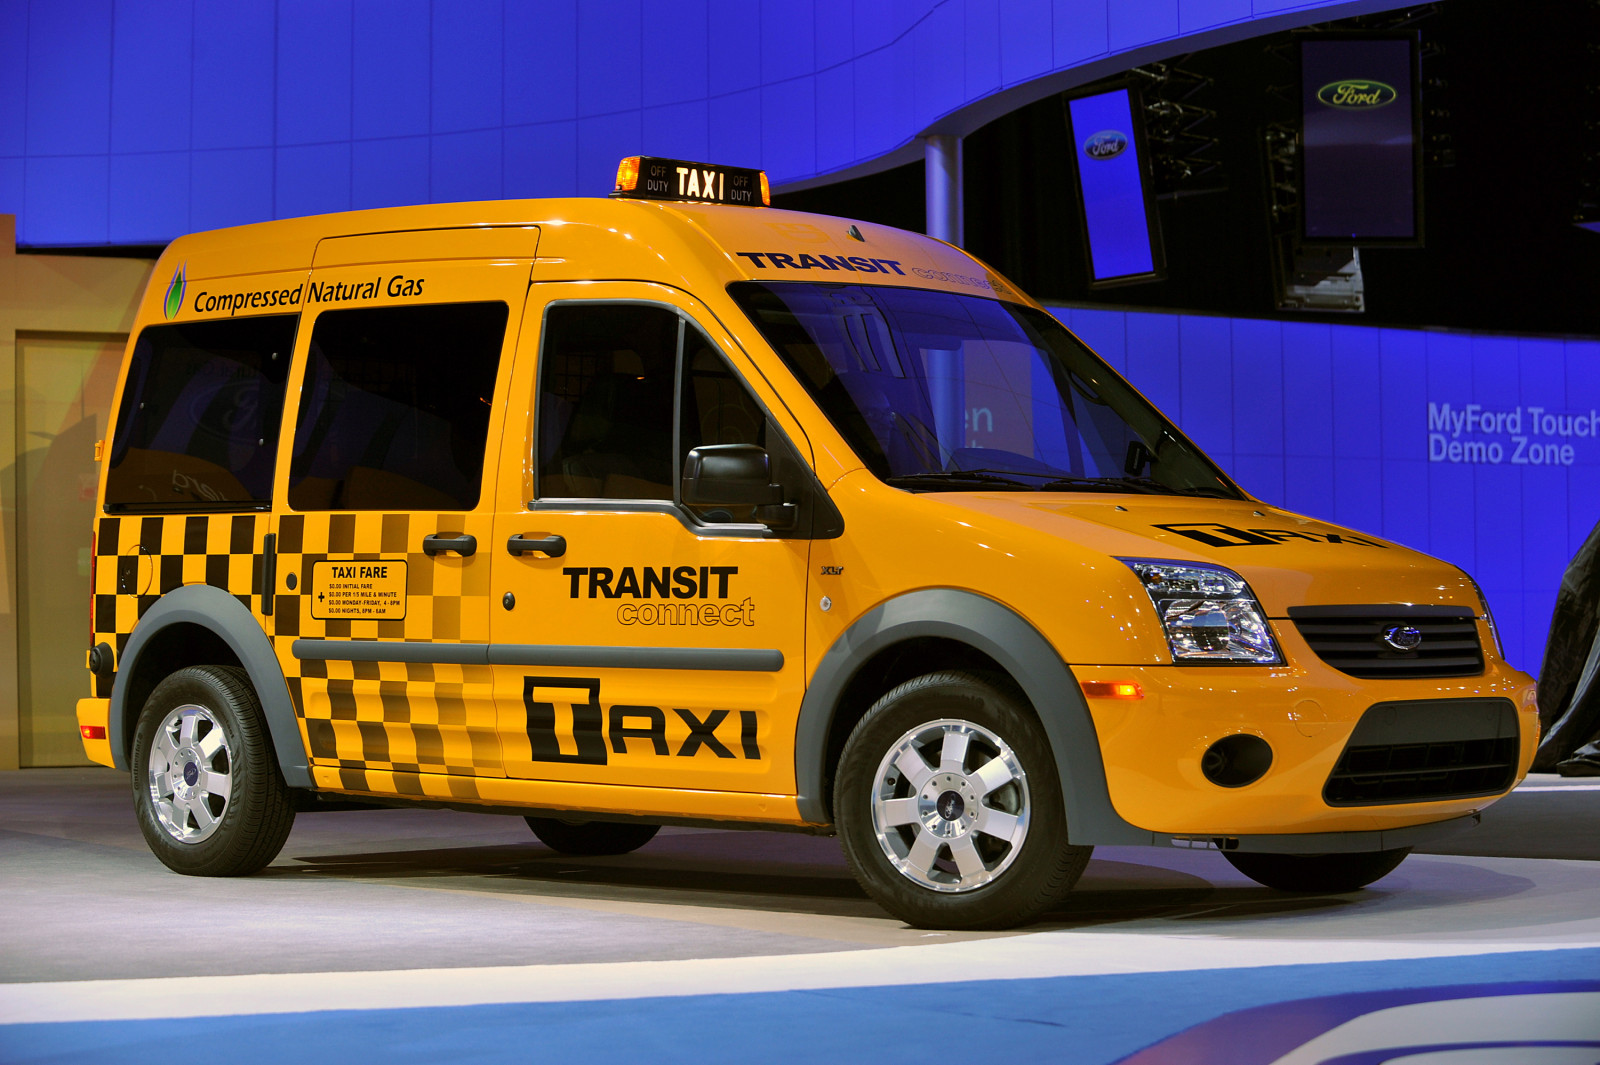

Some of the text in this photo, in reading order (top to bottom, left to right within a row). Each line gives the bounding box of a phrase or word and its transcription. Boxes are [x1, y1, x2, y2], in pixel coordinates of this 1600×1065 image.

[1333, 83, 1381, 105] Ford
[651, 165, 667, 177] OFF
[733, 175, 749, 188] OFF
[647, 179, 669, 193] DUTY
[676, 166, 725, 200] TAXI
[731, 189, 752, 202] DUTY
[736, 252, 906, 275] TRANSIT
[194, 275, 424, 316] Compressed Natural Gas
[1428, 402, 1522, 438] MyFord
[1428, 433, 1575, 465] Demo Zone
[331, 566, 388, 578] TAXI FARE
[821, 566, 844, 575] XLT
[563, 566, 739, 599] TRANSIT
[616, 597, 755, 627] connect
[523, 676, 761, 766] TAXI
